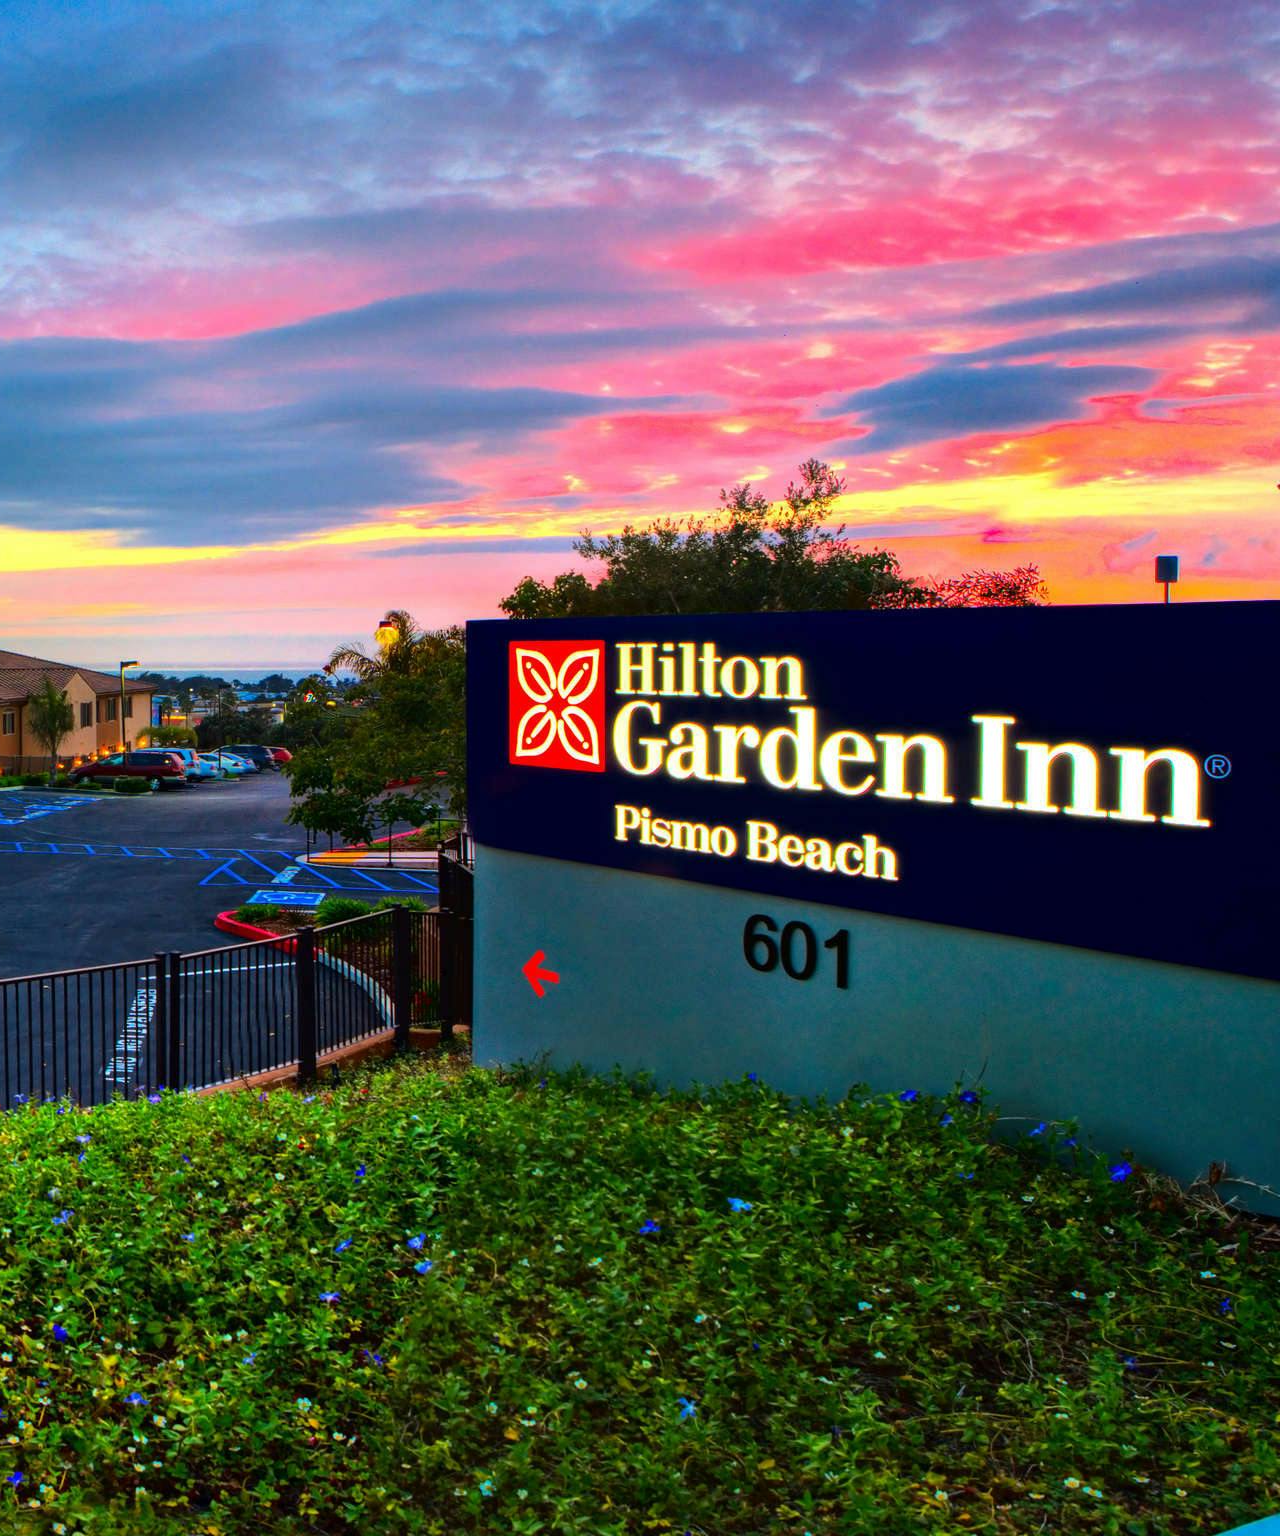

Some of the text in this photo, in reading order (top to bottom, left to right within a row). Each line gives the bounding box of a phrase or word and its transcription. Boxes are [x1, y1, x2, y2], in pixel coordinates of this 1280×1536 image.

[615, 642, 808, 701] Hilton
[612, 700, 955, 804] Garden
[969, 714, 1211, 828] Inn
[614, 804, 899, 881] Pismo Beach
[742, 914, 849, 989] 601
